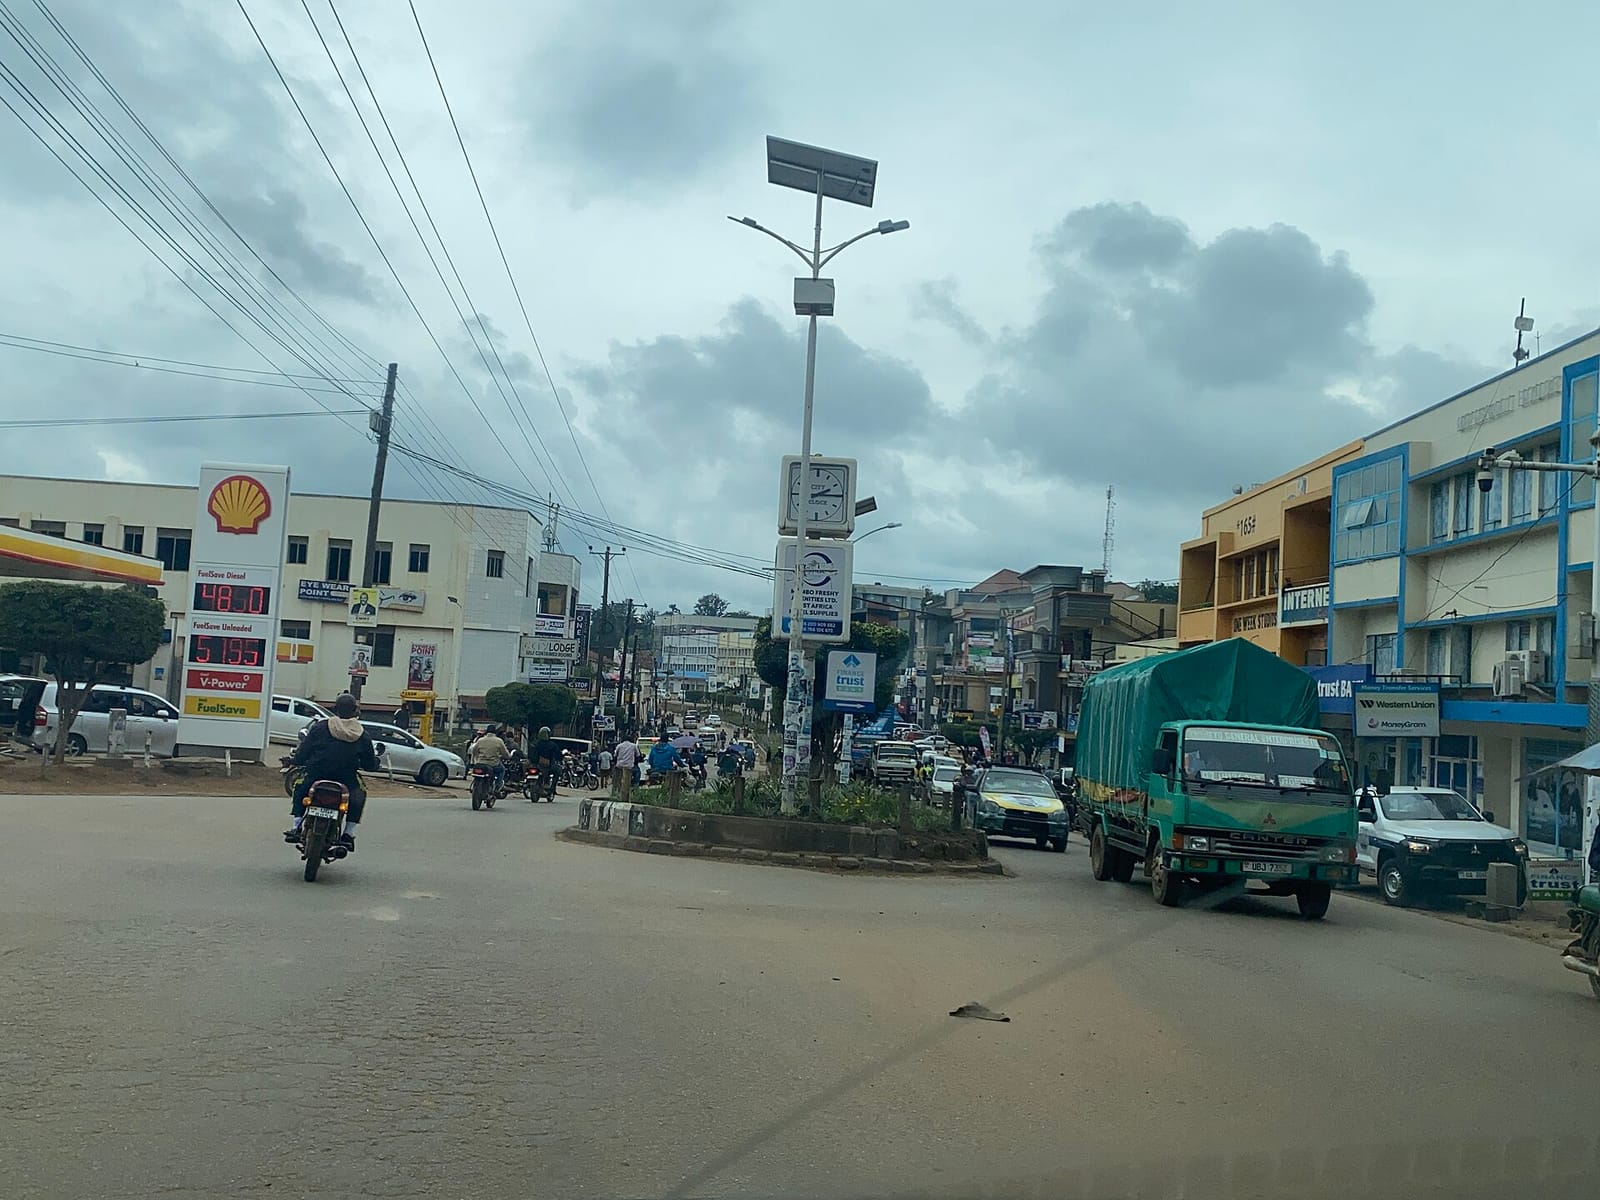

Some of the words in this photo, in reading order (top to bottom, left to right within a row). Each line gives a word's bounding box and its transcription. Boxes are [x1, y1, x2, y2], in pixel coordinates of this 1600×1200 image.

[198, 570, 225, 578] FuelSave
[226, 572, 246, 580] Diesel
[300, 580, 319, 589] EYE
[321, 582, 349, 592] WEAR
[300, 588, 329, 596] POINT
[193, 622, 220, 630] FuelSave
[222, 624, 252, 632] Unleaded
[549, 642, 576, 653] LODGE
[200, 677, 247, 689] V-Power
[837, 675, 864, 686] trust
[1317, 680, 1339, 697] trust
[197, 702, 246, 714] FuelSave
[1411, 701, 1435, 709] Union
[1224, 732, 1260, 743] GENERAL
[1230, 832, 1309, 845] CANTER
[1530, 880, 1580, 889] trust
